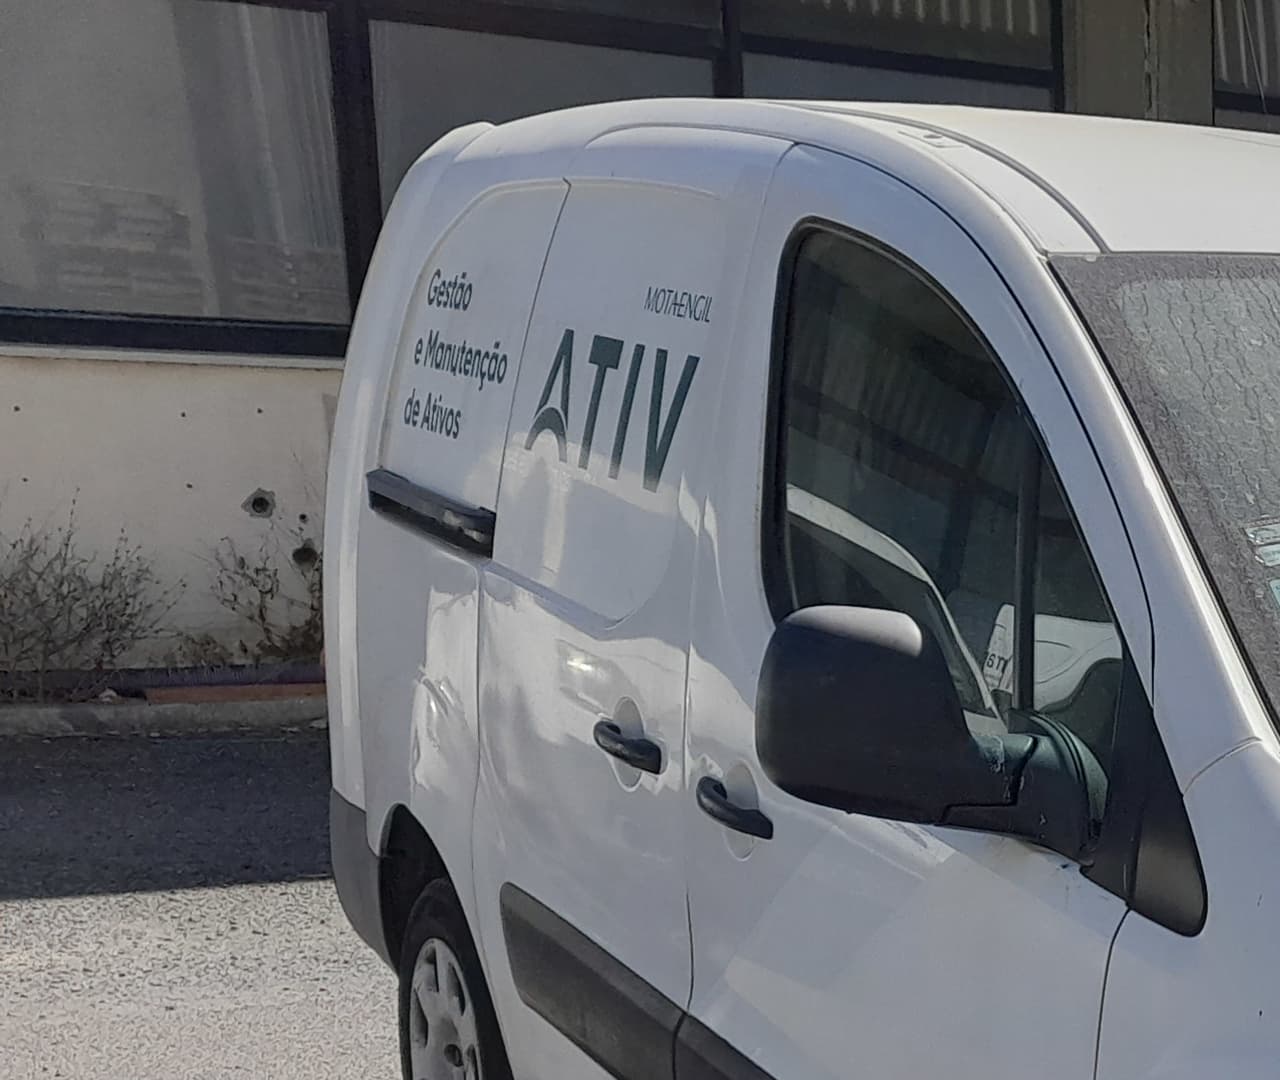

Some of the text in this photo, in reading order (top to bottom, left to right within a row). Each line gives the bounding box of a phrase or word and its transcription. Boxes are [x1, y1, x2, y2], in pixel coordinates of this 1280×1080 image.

[427, 268, 472, 311] Gestão
[414, 329, 508, 392] e Manutenção
[403, 387, 461, 439] de Ativos
[524, 328, 700, 493] ATIV
